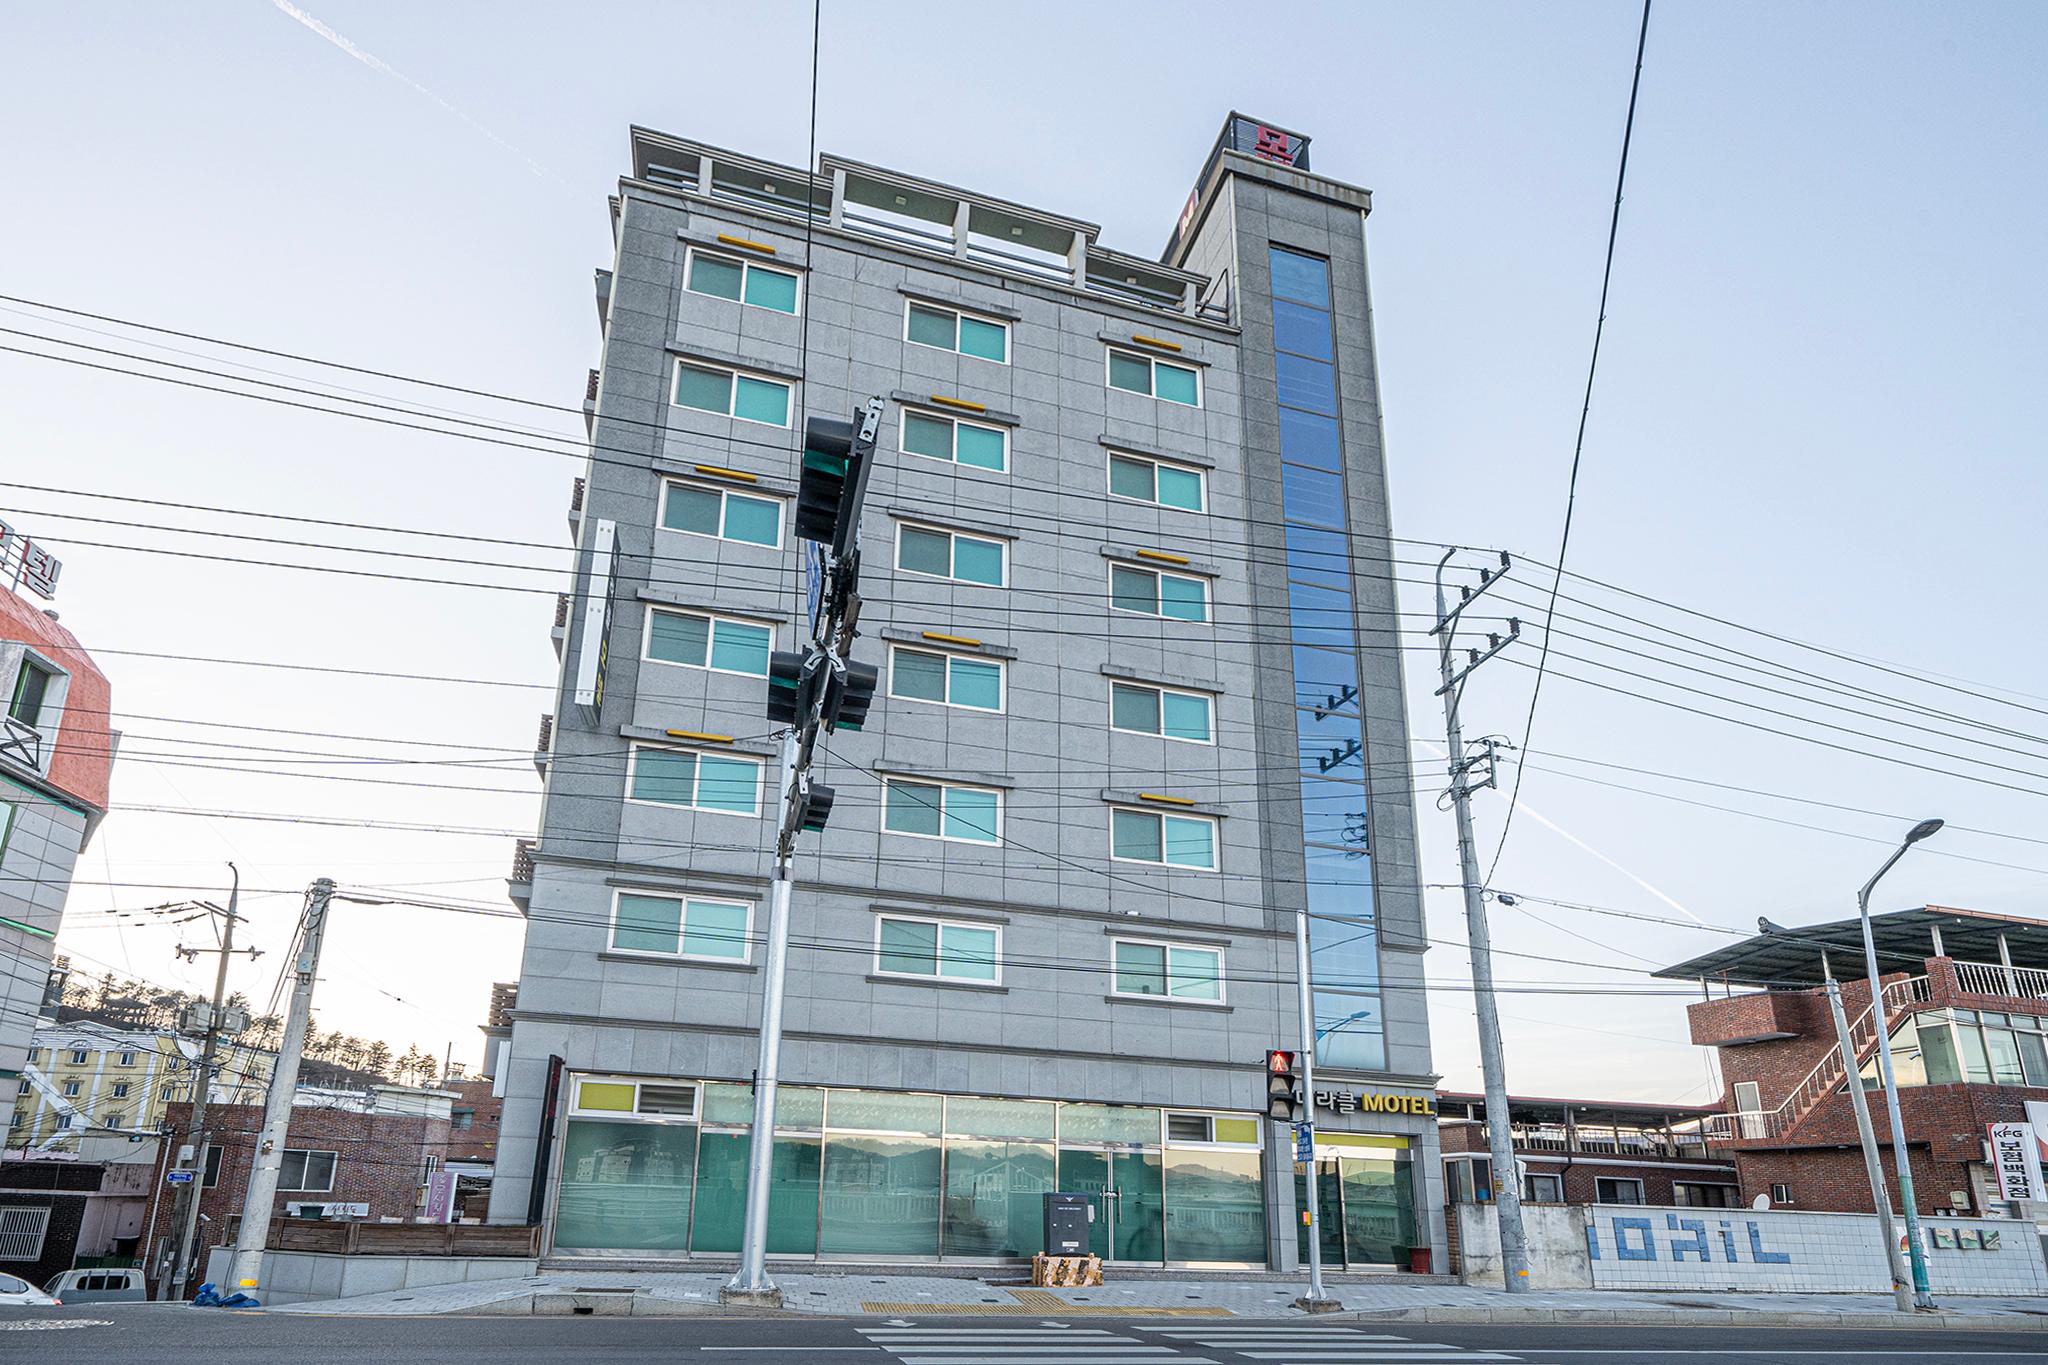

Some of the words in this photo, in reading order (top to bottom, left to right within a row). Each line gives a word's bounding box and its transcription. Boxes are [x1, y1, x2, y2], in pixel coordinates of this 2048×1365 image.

[1254, 126, 1294, 166] 모
[1362, 1093, 1435, 1115] MOTEL
[1993, 1127, 2023, 1138] KFG
[2000, 1141, 2030, 1198] 보험백화점
